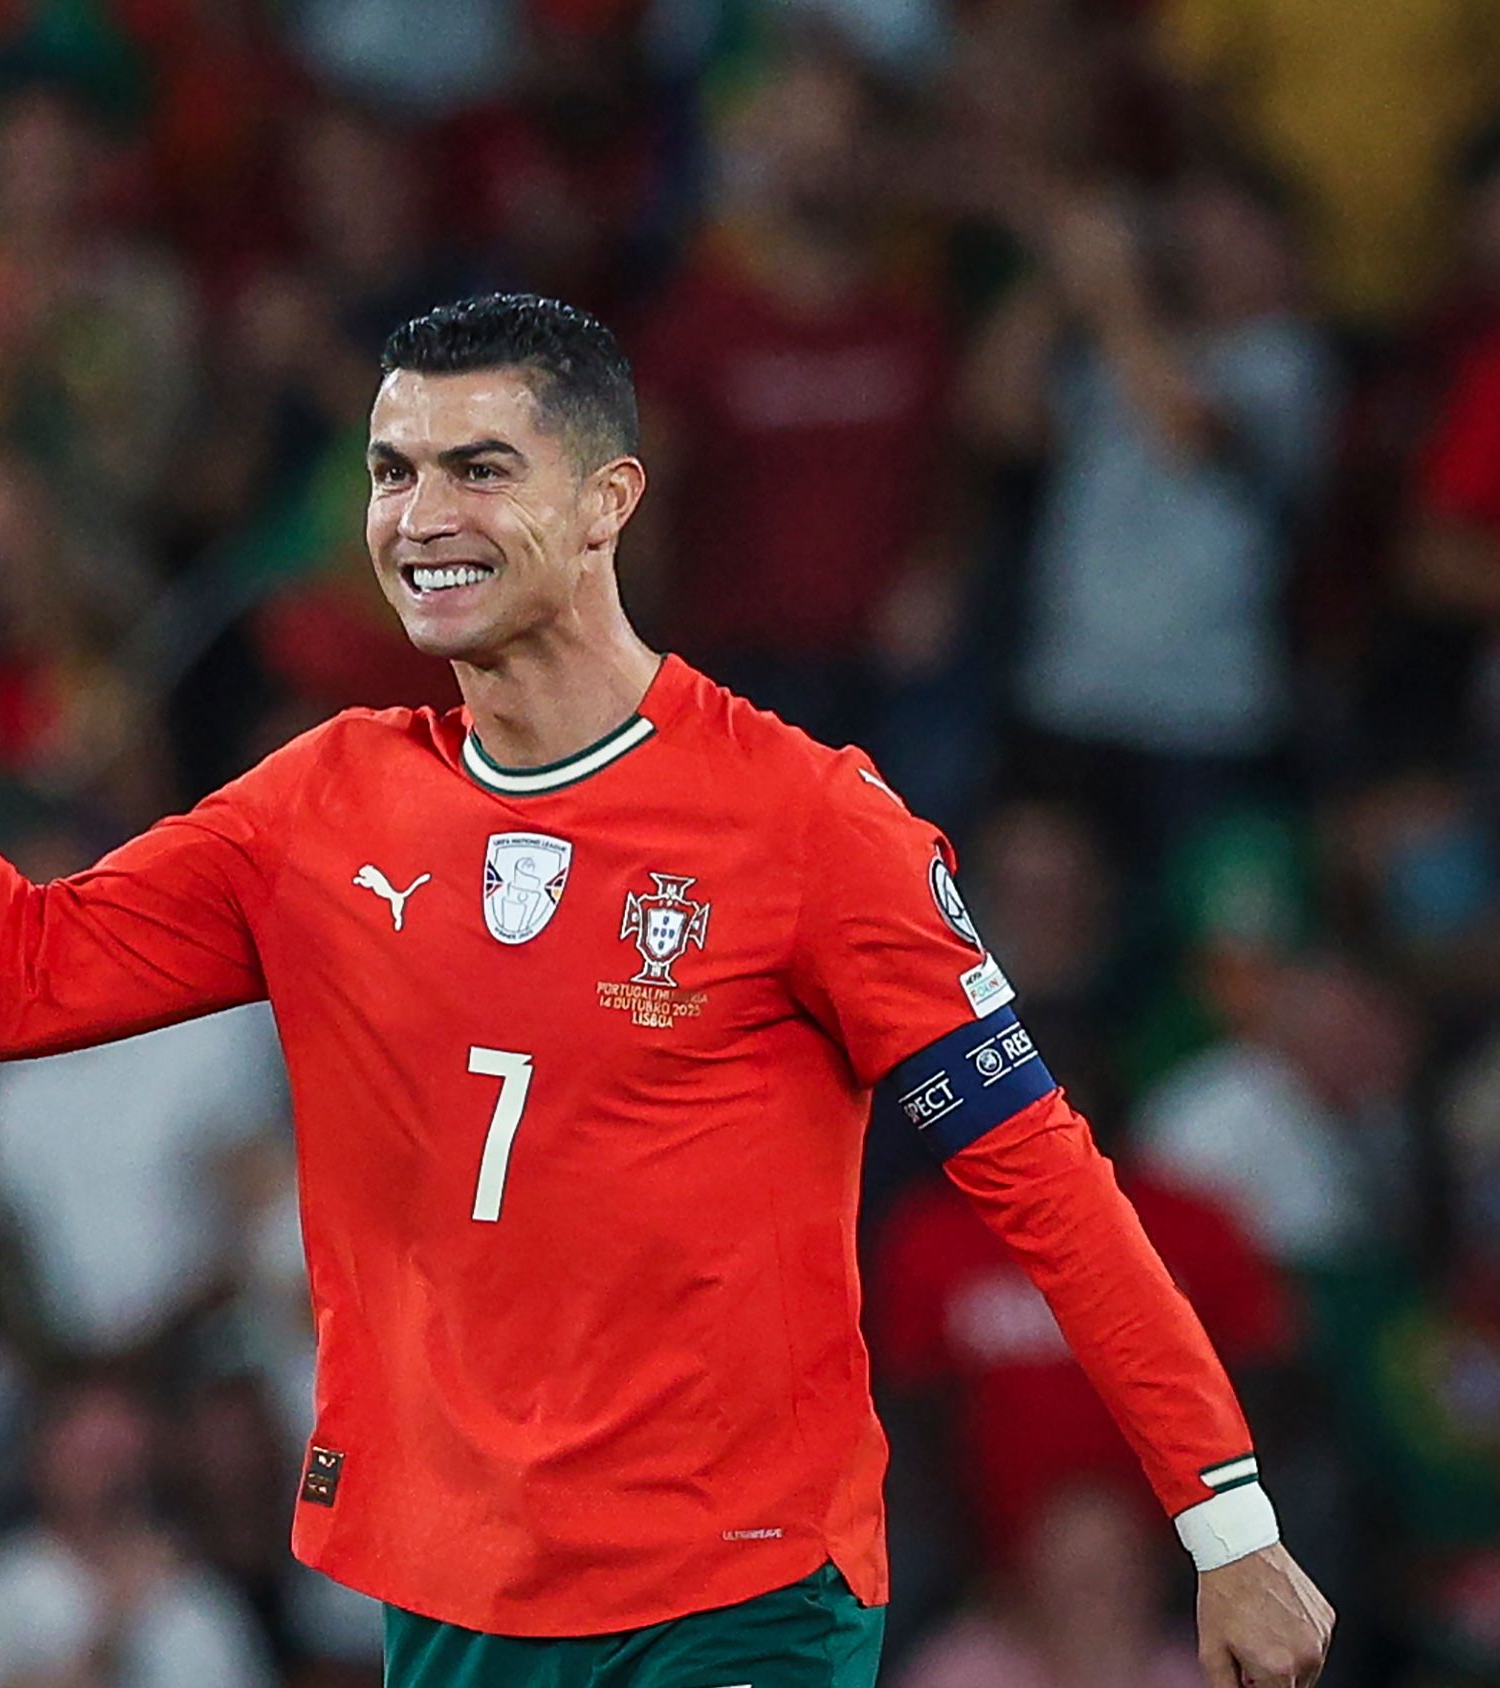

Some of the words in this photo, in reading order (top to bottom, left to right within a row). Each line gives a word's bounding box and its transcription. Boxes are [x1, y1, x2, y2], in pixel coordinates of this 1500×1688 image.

[613, 996, 671, 1016] OUTUBRO
[631, 1011, 674, 1029] LISBOA
[1001, 1029, 1033, 1061] RES
[467, 1045, 534, 1223] 7
